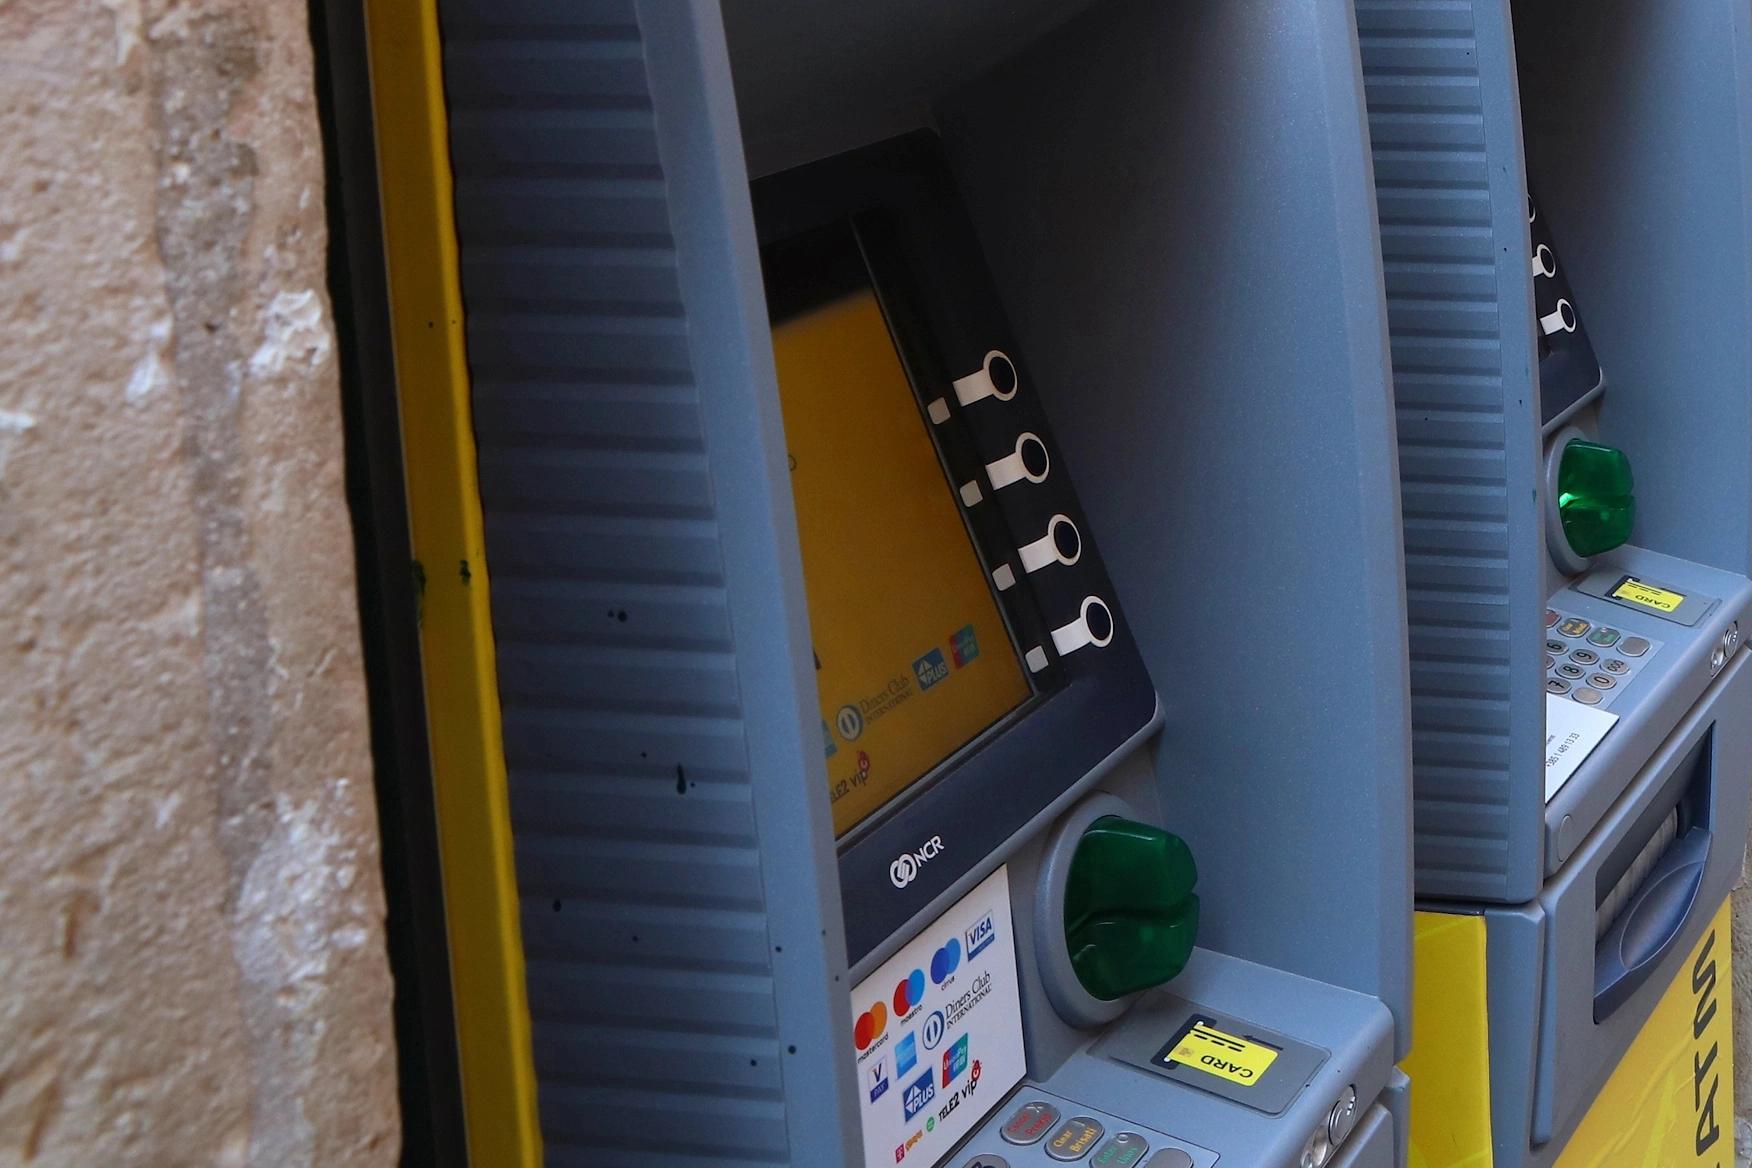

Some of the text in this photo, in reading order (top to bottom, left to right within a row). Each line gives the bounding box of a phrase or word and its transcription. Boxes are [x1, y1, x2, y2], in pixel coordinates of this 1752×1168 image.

[1635, 595, 1671, 609] CARD
[926, 662, 949, 685] PLUS
[912, 835, 945, 867] NCR
[968, 917, 992, 945] VISA
[945, 970, 991, 1019] Diners Club
[1692, 928, 1720, 1157] ATM
[1200, 1055, 1254, 1079] CARD
[913, 1083, 935, 1113] PLUS
[938, 1079, 977, 1122] TELE2 vip
